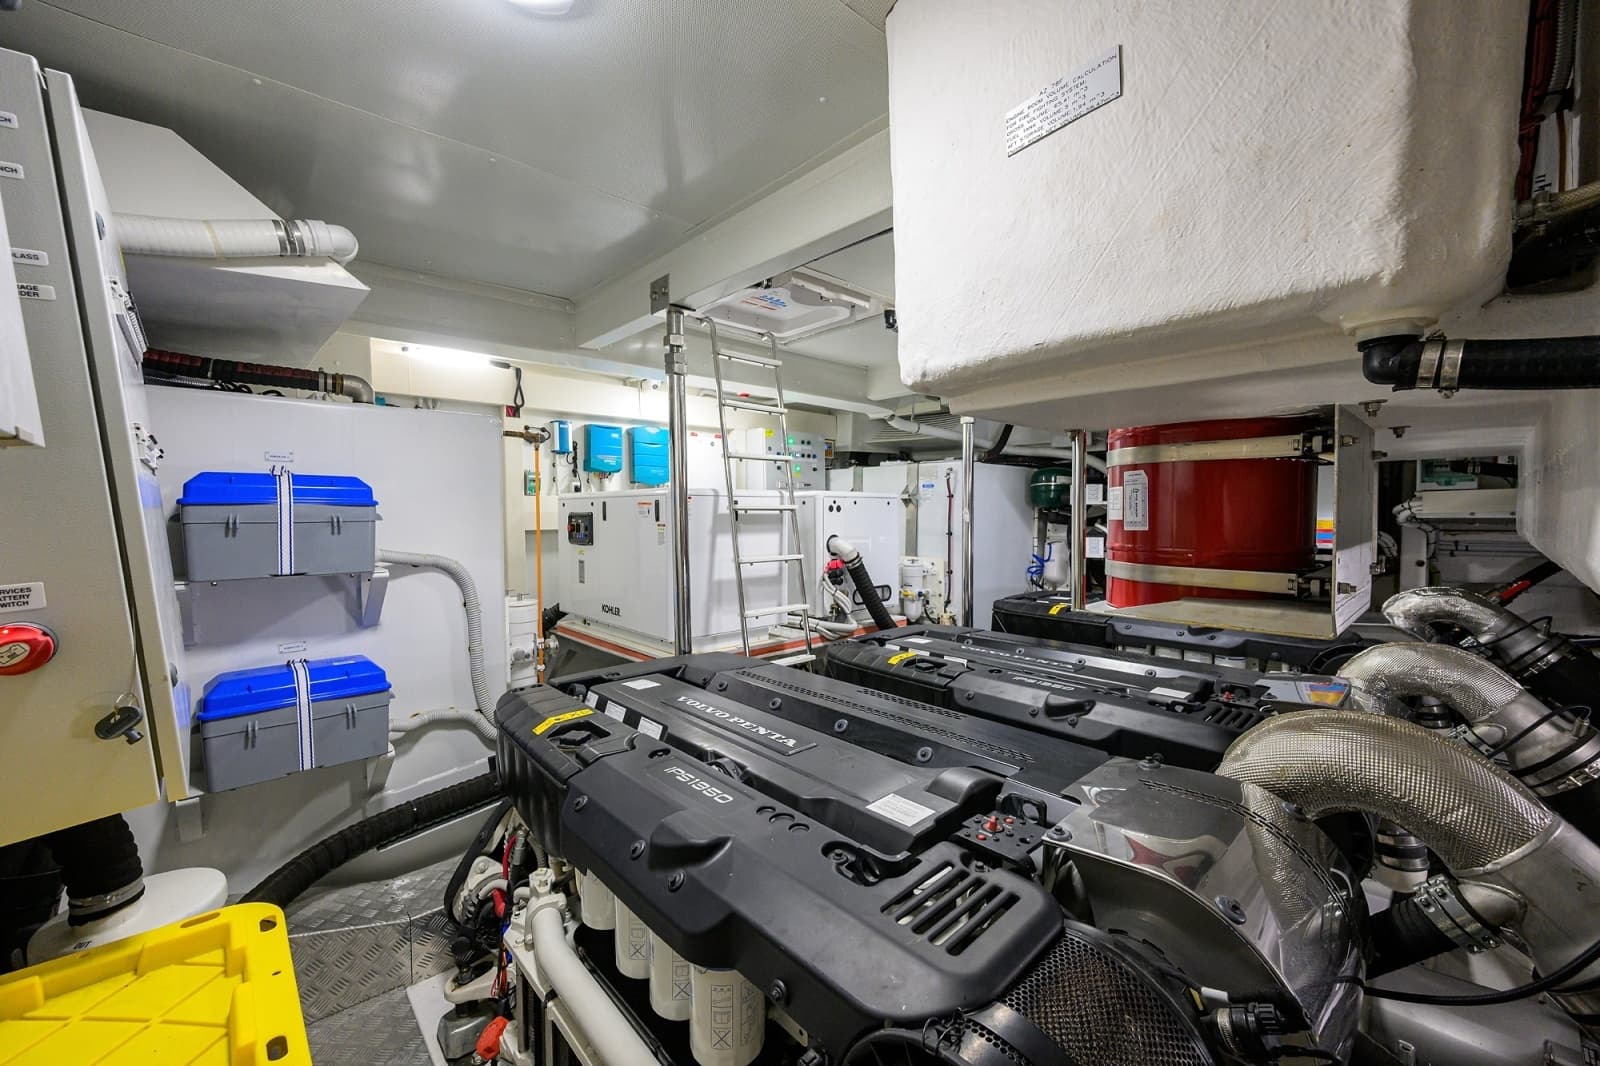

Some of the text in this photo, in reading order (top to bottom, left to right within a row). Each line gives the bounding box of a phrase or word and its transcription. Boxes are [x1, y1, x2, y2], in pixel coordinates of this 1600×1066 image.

[1027, 97, 1043, 111] ROOM
[1046, 80, 1070, 99] VOLUME
[1073, 55, 1117, 83] CALCULATION
[1032, 95, 1058, 116] FIGHTING
[12, 252, 39, 260] LASS
[602, 604, 621, 617] KOHLER
[676, 695, 798, 748] VOLVO PENTA
[663, 766, 734, 804] IPS1350
